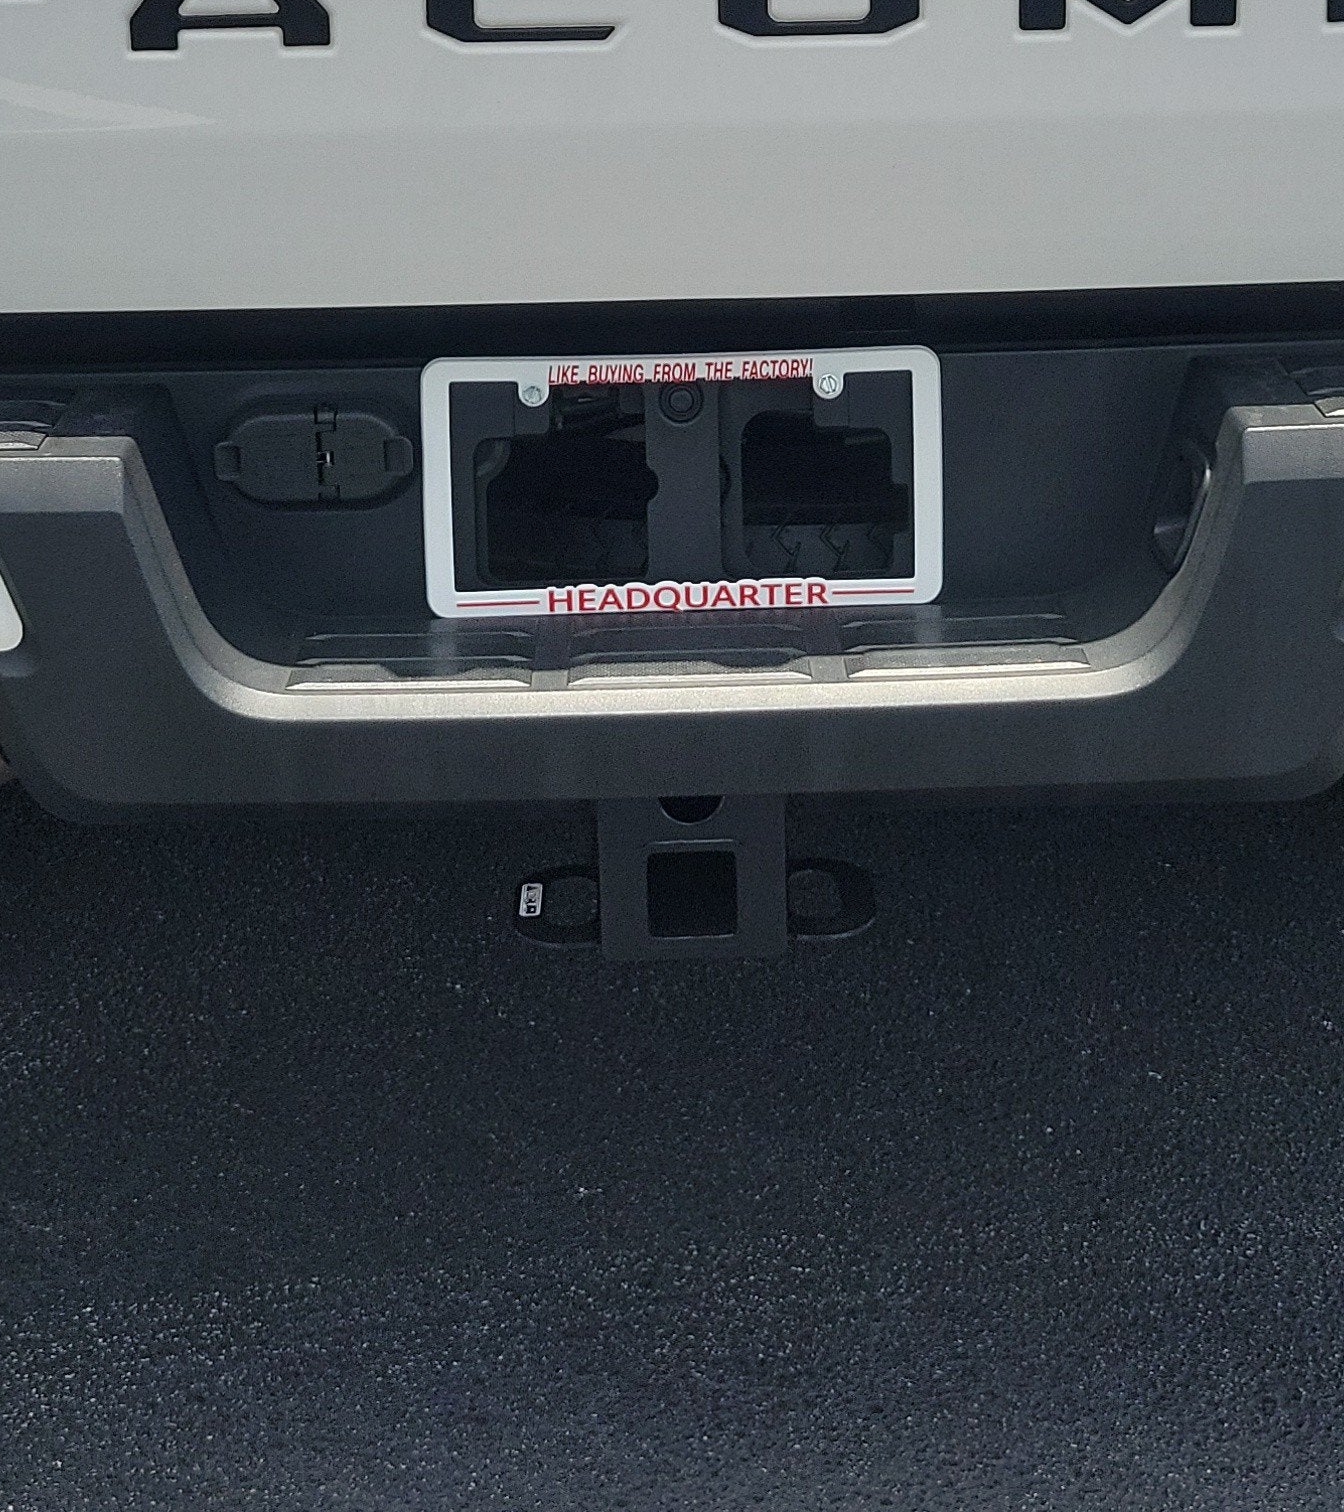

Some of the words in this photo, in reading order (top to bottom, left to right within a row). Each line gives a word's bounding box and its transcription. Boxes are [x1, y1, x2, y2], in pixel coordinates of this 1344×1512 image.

[548, 364, 580, 385] LIKE
[588, 363, 644, 385] BUYING
[653, 362, 697, 383] FROM
[705, 361, 733, 381] THE
[741, 358, 814, 380] FACTORY!
[548, 582, 828, 613] HEADQUARTER
